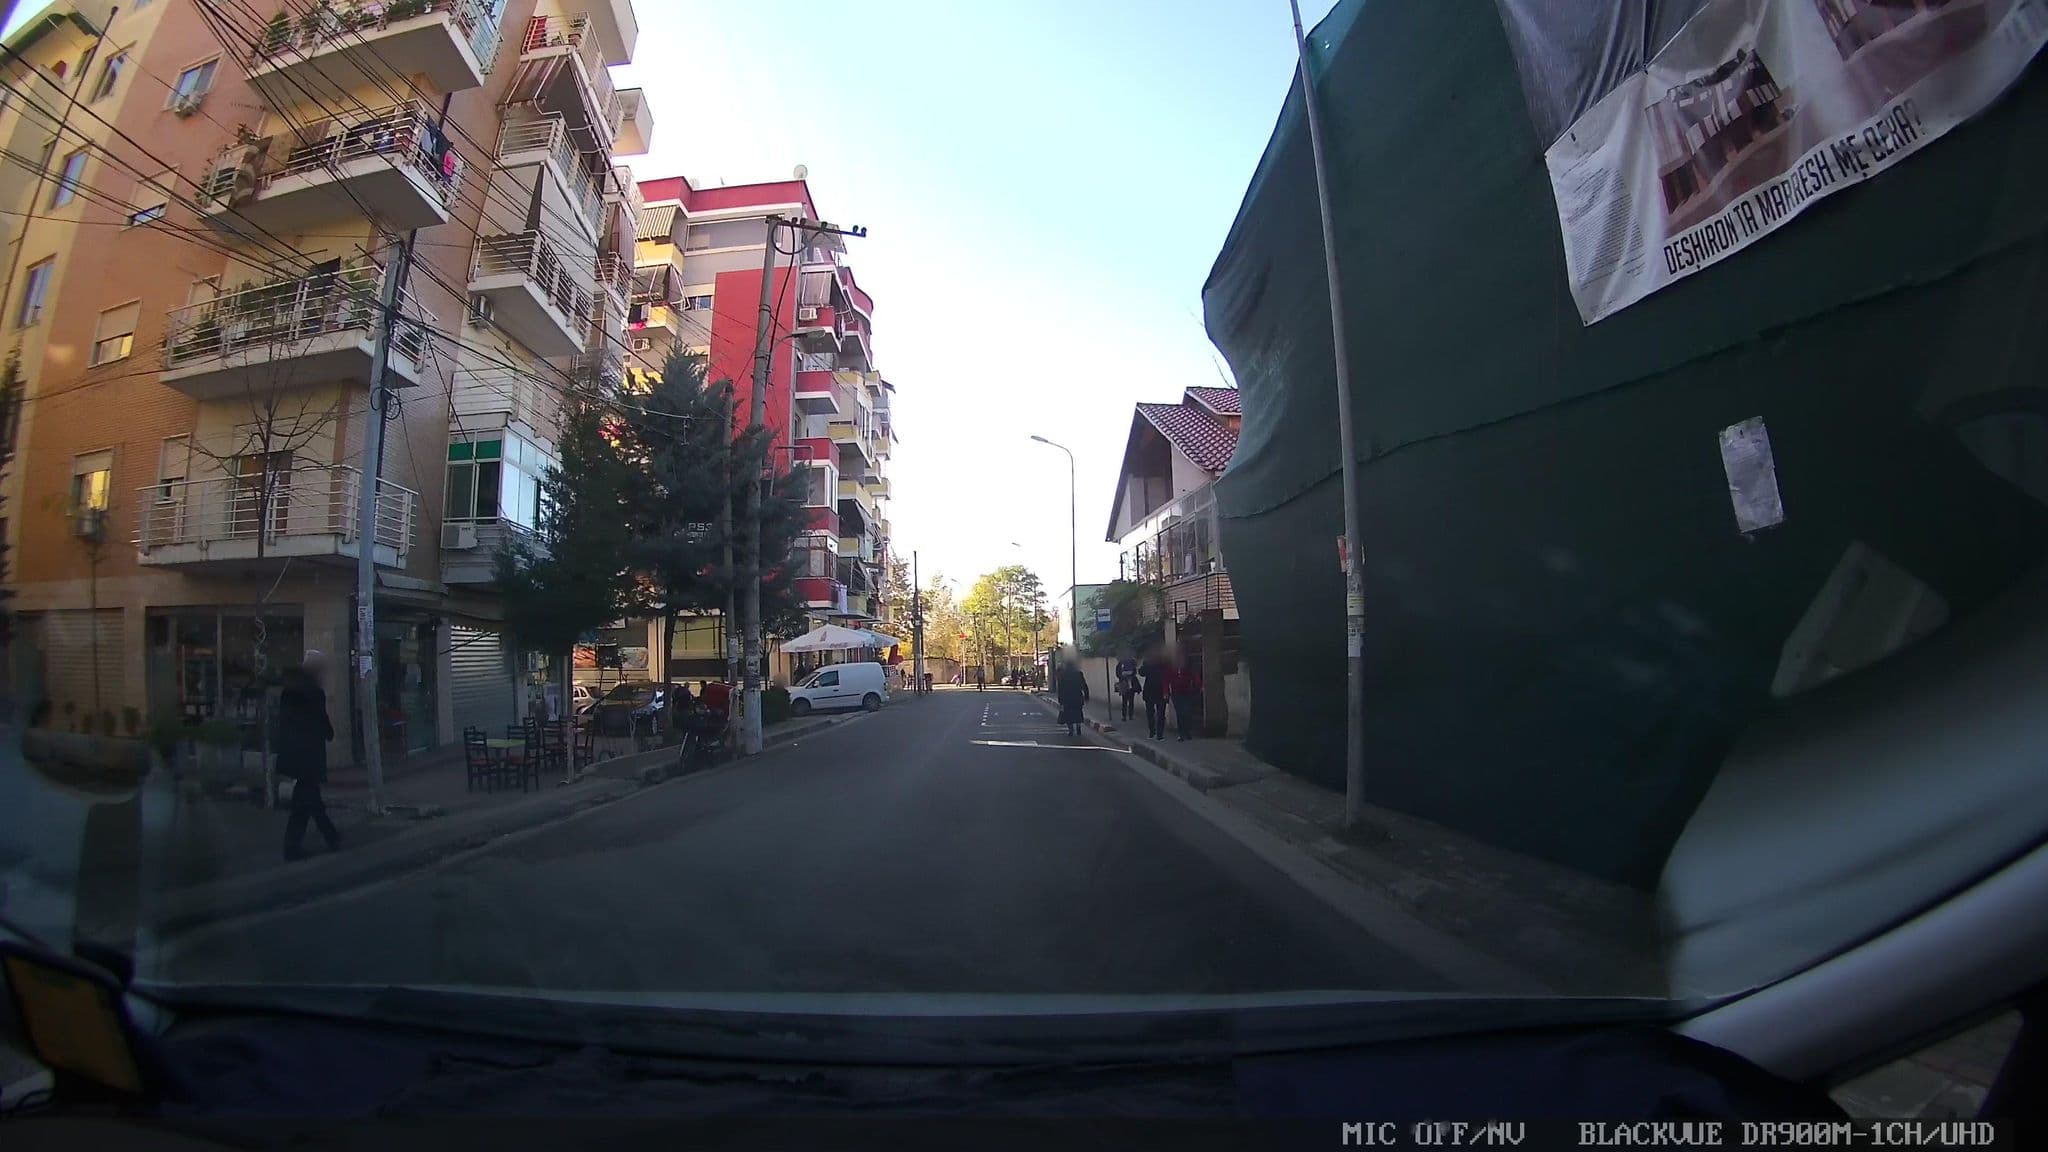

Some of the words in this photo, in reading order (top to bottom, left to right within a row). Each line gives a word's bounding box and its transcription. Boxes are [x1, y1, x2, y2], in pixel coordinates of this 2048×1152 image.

[1663, 211, 1740, 276] DESHIRON
[1733, 200, 1759, 237] TA
[1754, 151, 1836, 226] MARRESH
[1830, 134, 1870, 178] ME
